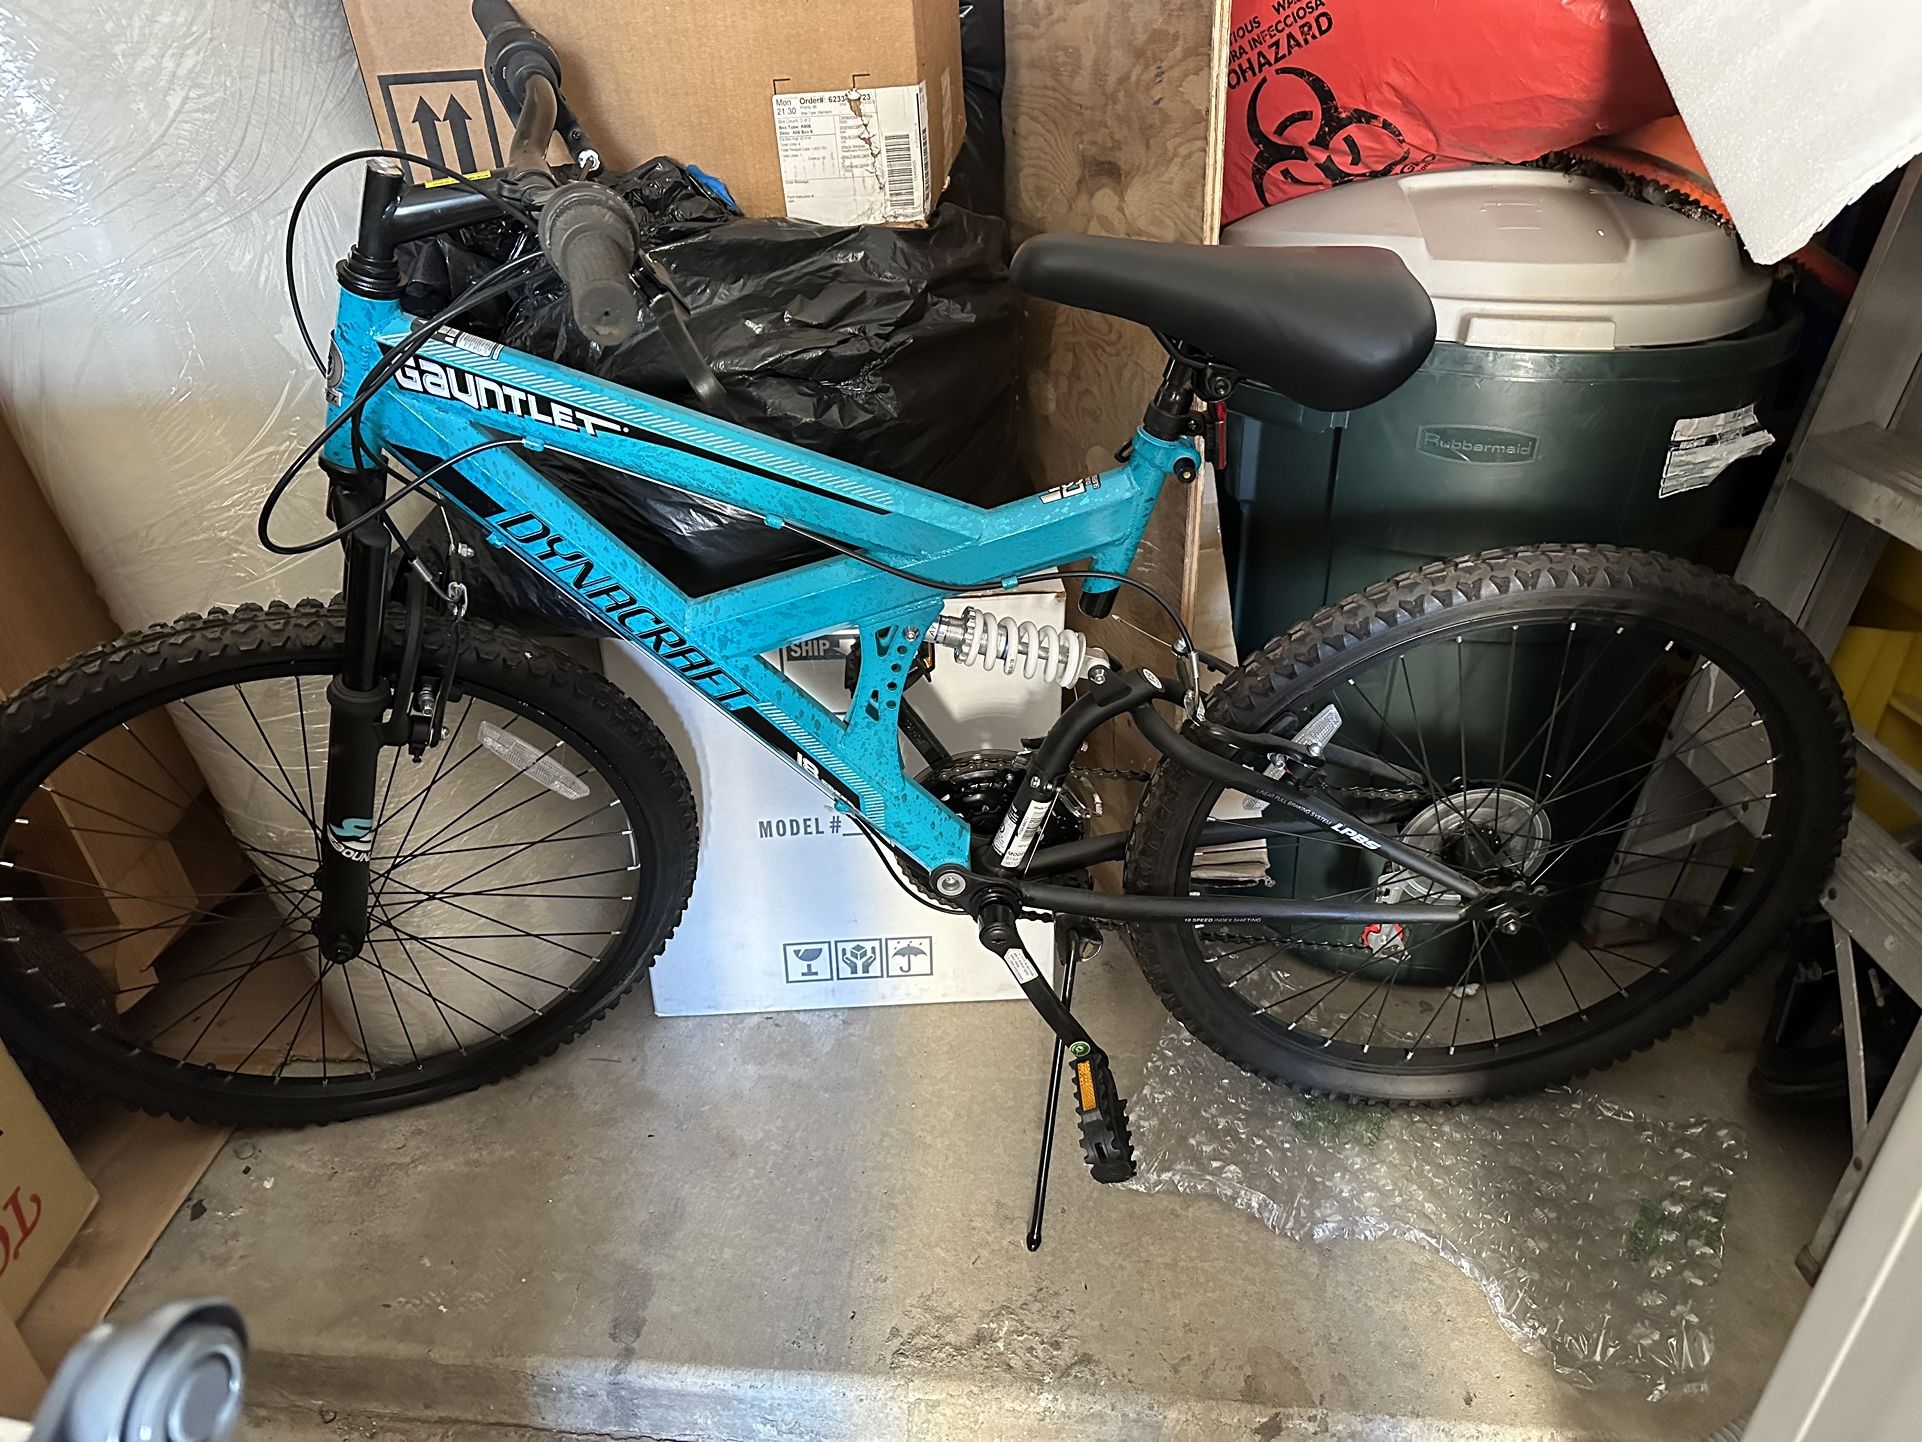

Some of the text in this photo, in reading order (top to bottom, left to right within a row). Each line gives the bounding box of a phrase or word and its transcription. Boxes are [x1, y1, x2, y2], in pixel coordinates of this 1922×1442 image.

[1248, 0, 1325, 51] INFECCIOSA
[776, 98, 792, 106] Mon
[1423, 432, 1531, 456] Rubbermaid
[499, 512, 759, 706] DYNACRAFT
[790, 639, 830, 657] SHIP
[759, 817, 824, 838] MODEL
[1275, 796, 1288, 804] PULL
[1287, 801, 1310, 814] BRAKING
[1310, 811, 1332, 825] SYSTEM
[1331, 823, 1382, 850] LPBS
